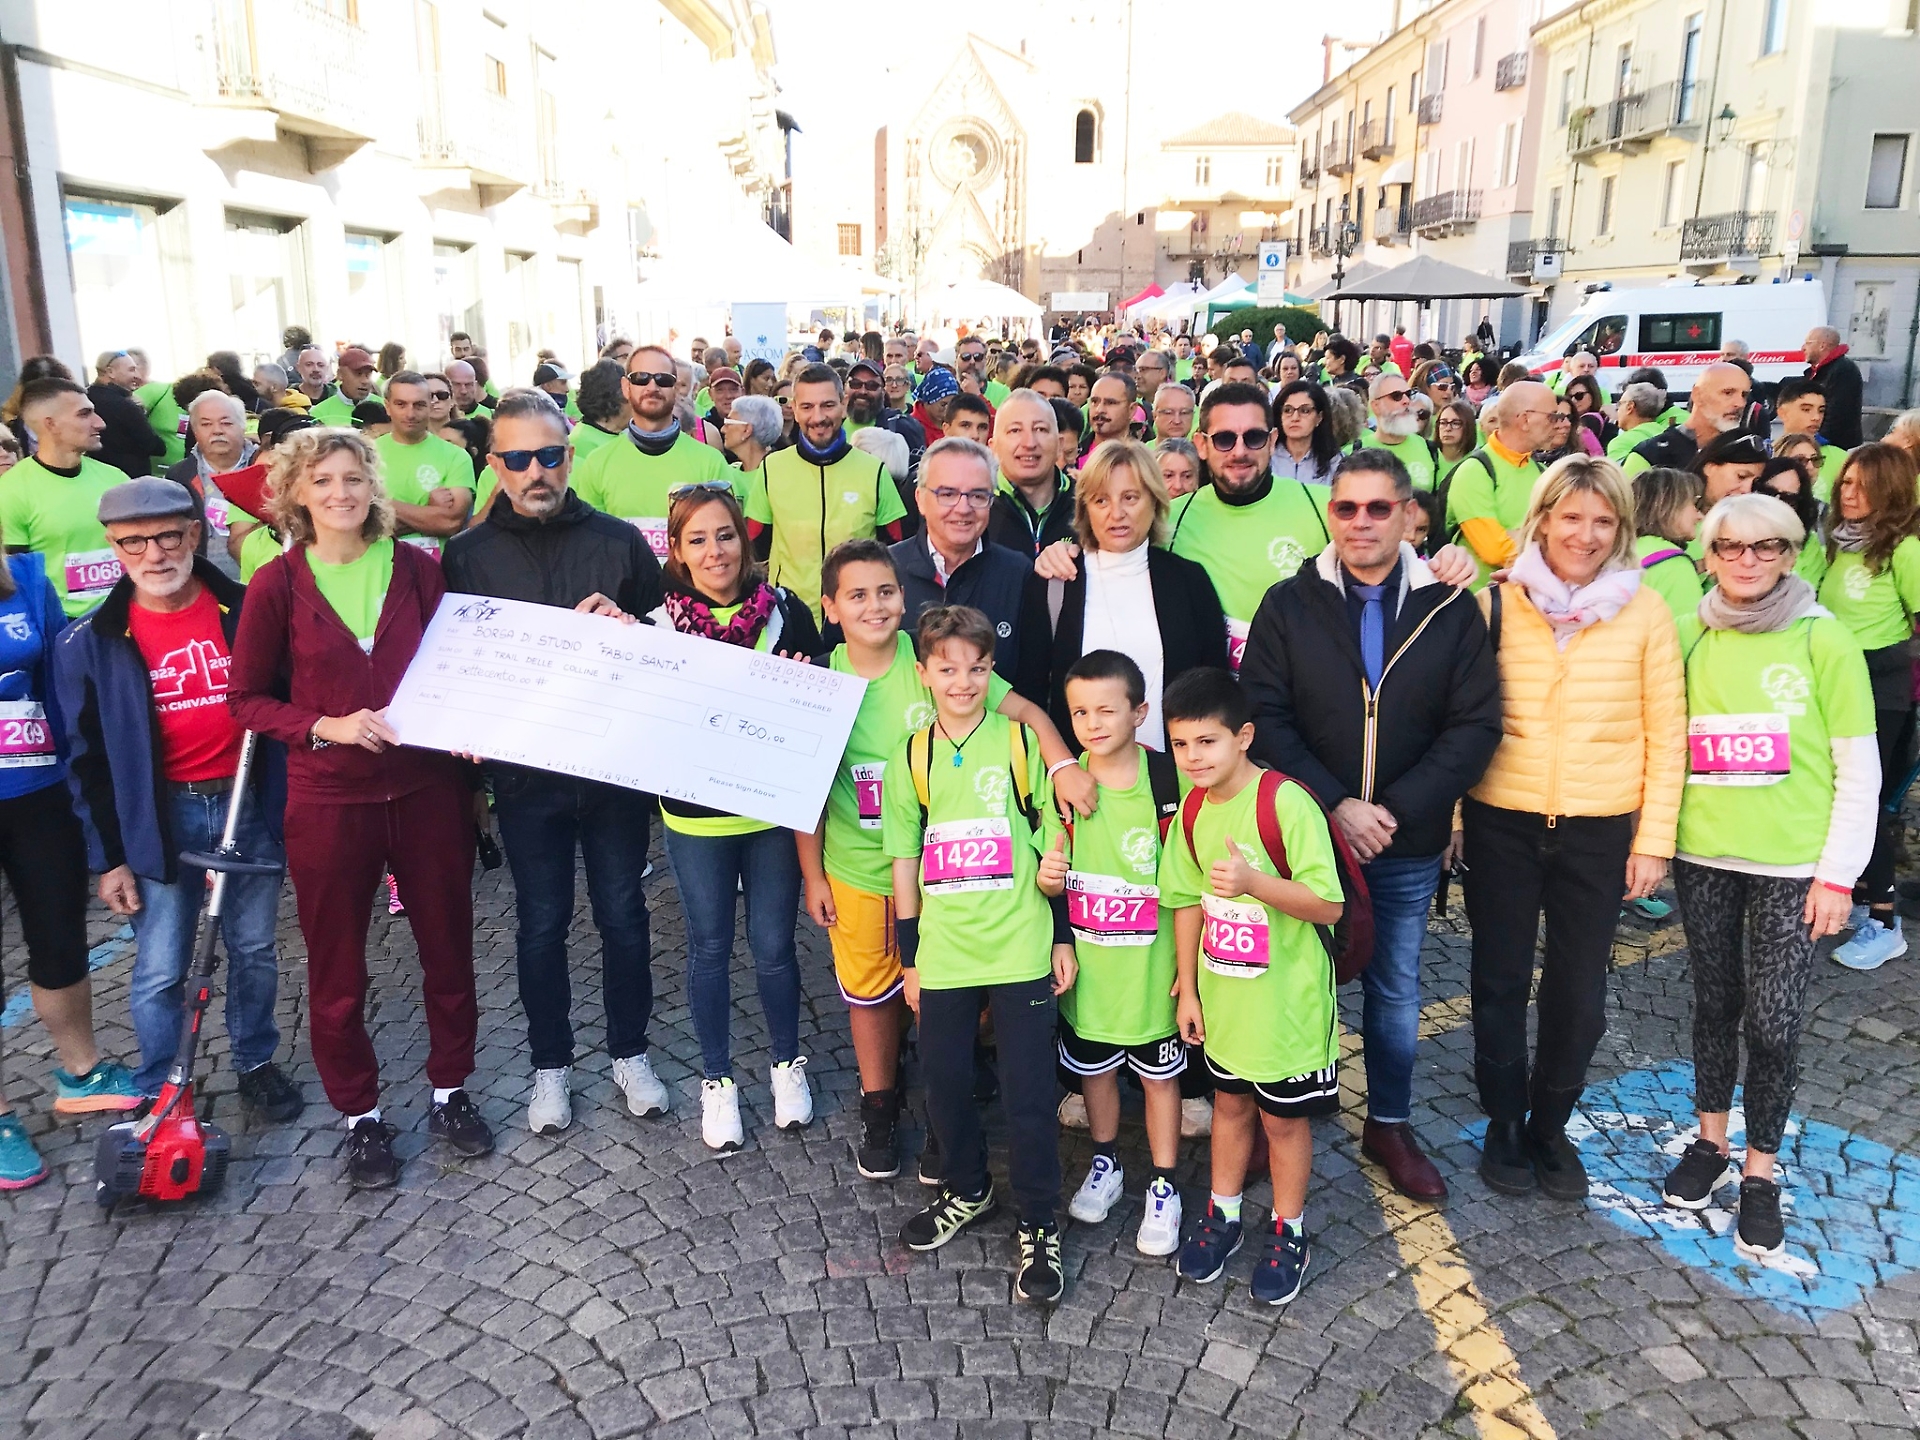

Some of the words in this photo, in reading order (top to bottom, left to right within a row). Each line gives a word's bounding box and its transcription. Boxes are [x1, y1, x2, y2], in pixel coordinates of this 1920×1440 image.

[744, 348, 783, 361] ASCOM
[1640, 354, 1676, 366] Croce
[76, 562, 122, 583] 1068
[472, 625, 515, 640] BORSA
[520, 632, 532, 643] DI
[537, 635, 582, 651] STUDIO
[150, 666, 177, 681] 922
[494, 650, 518, 662] TRAIL
[525, 656, 553, 668] DELLE
[563, 663, 599, 677] COLLINE
[802, 701, 833, 714] BEARER
[709, 714, 723, 728] €
[1700, 736, 1775, 762] 1493
[708, 776, 733, 788] Please
[735, 783, 752, 794] Sign
[753, 787, 777, 799] Above
[934, 840, 999, 871] 1422
[1067, 874, 1084, 891] tdc
[1078, 894, 1146, 923] 1427
[1209, 920, 1255, 954] 426
[1157, 1038, 1179, 1064] 86
